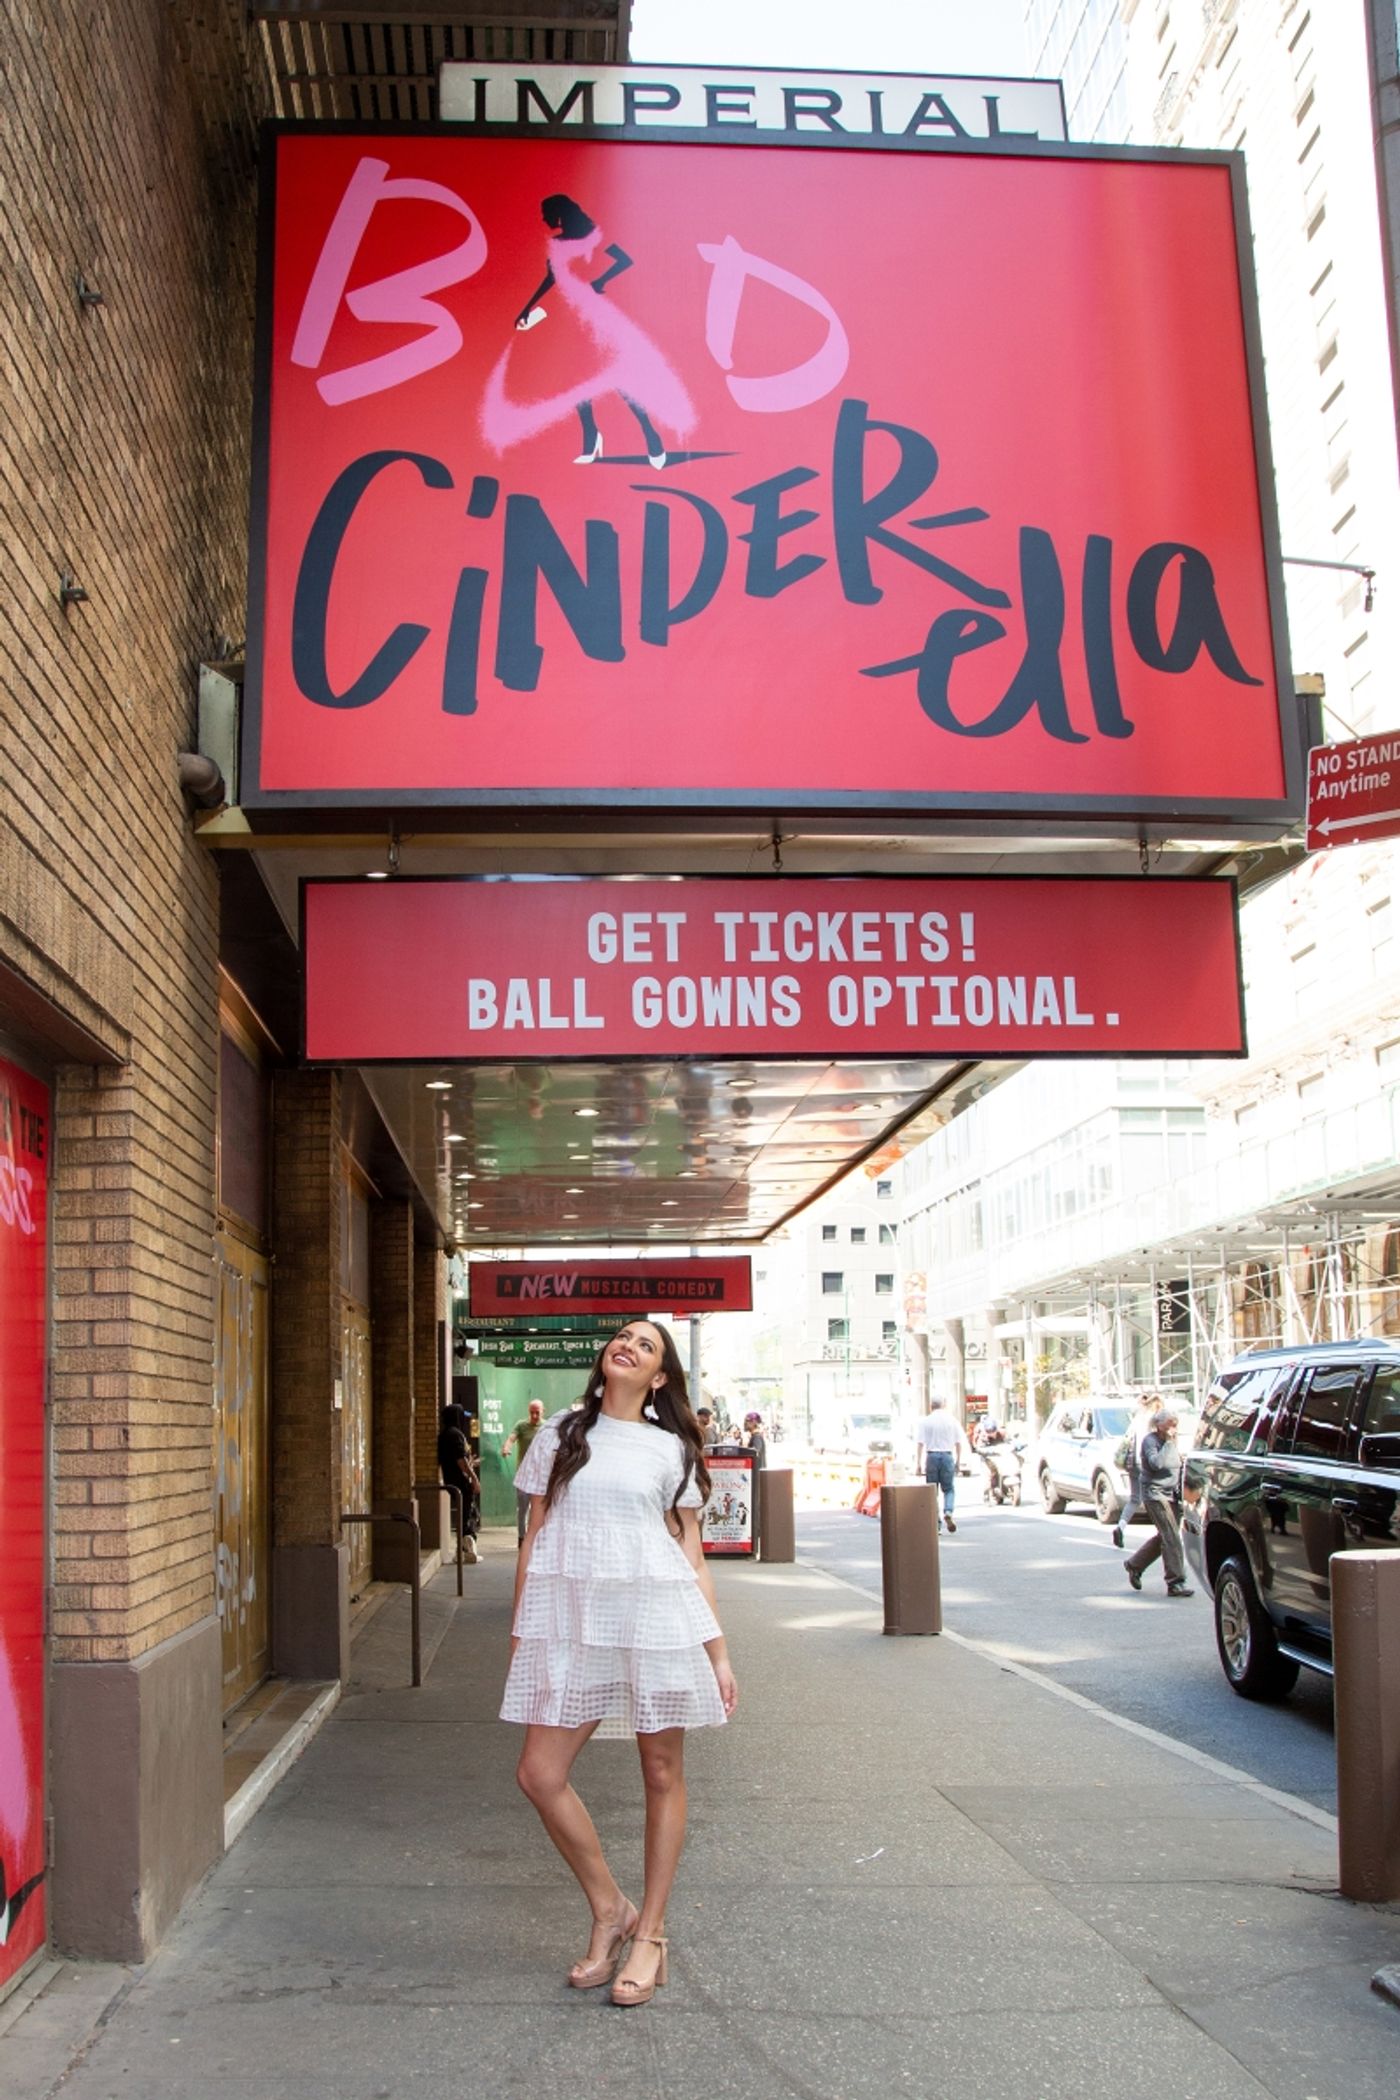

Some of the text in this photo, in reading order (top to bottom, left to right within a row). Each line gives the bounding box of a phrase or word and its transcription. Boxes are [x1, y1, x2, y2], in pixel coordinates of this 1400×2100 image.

[472, 78, 1039, 138] IMPERIAL
[1317, 741, 1400, 776] NO STAND
[1317, 771, 1391, 800] Anytime
[587, 911, 976, 964] GET TICKETS!
[468, 974, 1120, 1030] BALL GOWNS OPTIONAL.
[19, 1105, 44, 1159] THE
[503, 1271, 716, 1300] A NEW MUSICAL COMEDY
[482, 1399, 502, 1409] POST
